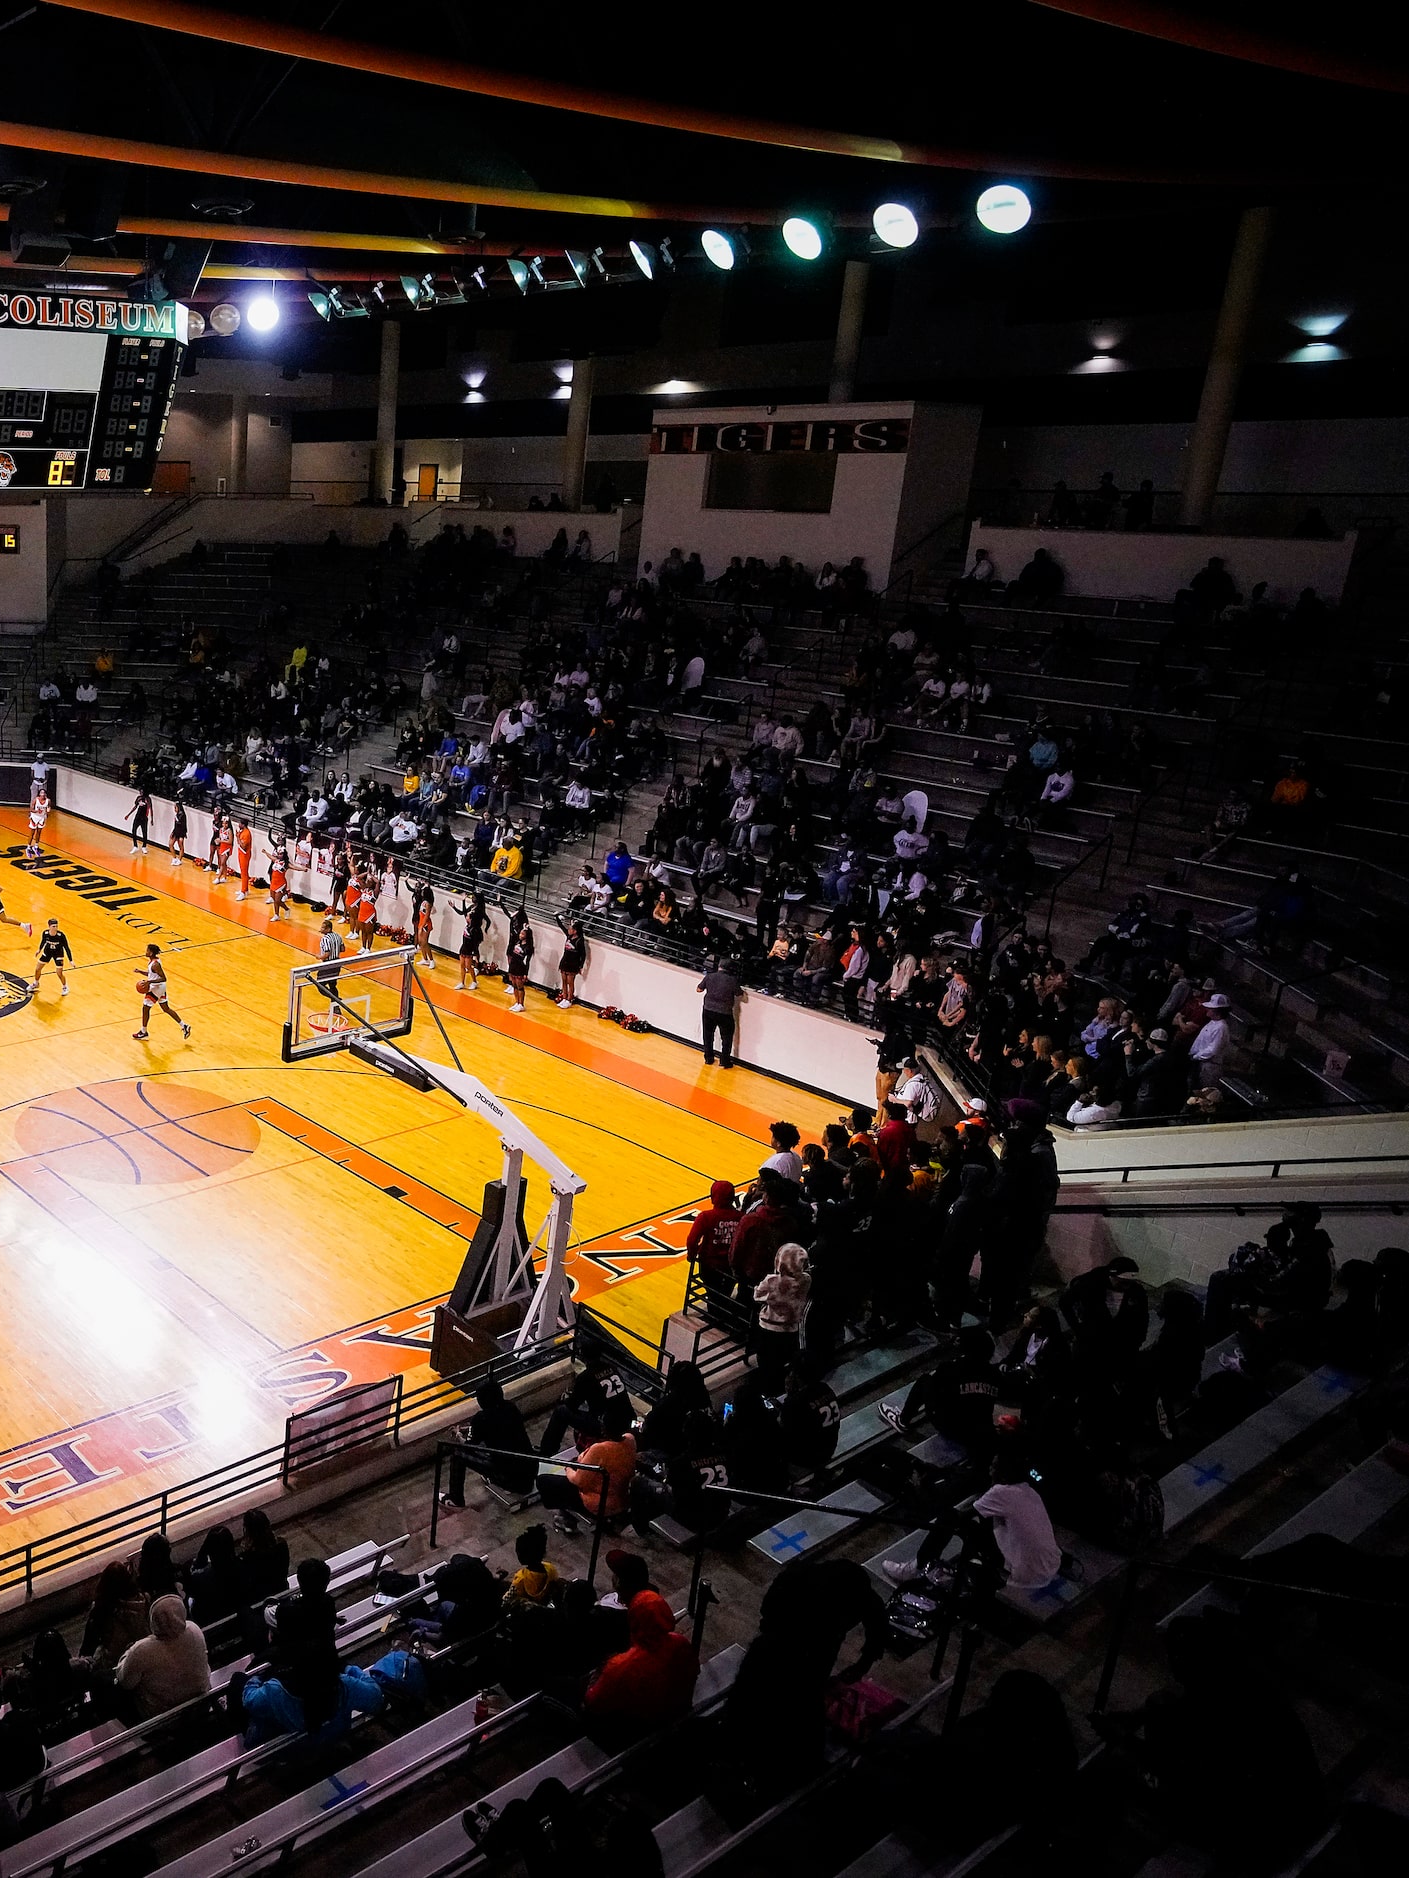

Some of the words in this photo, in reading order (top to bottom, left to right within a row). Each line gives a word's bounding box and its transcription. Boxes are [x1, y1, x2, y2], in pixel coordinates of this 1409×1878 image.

[650, 421, 909, 453] TIGERS
[54, 451, 77, 461] FOULS
[95, 468, 112, 481] TOL
[4, 534, 16, 548] 15
[103, 912, 192, 946] LADY
[599, 1374, 625, 1399] 23
[818, 1400, 841, 1428] 23
[699, 1464, 729, 1490] 23
